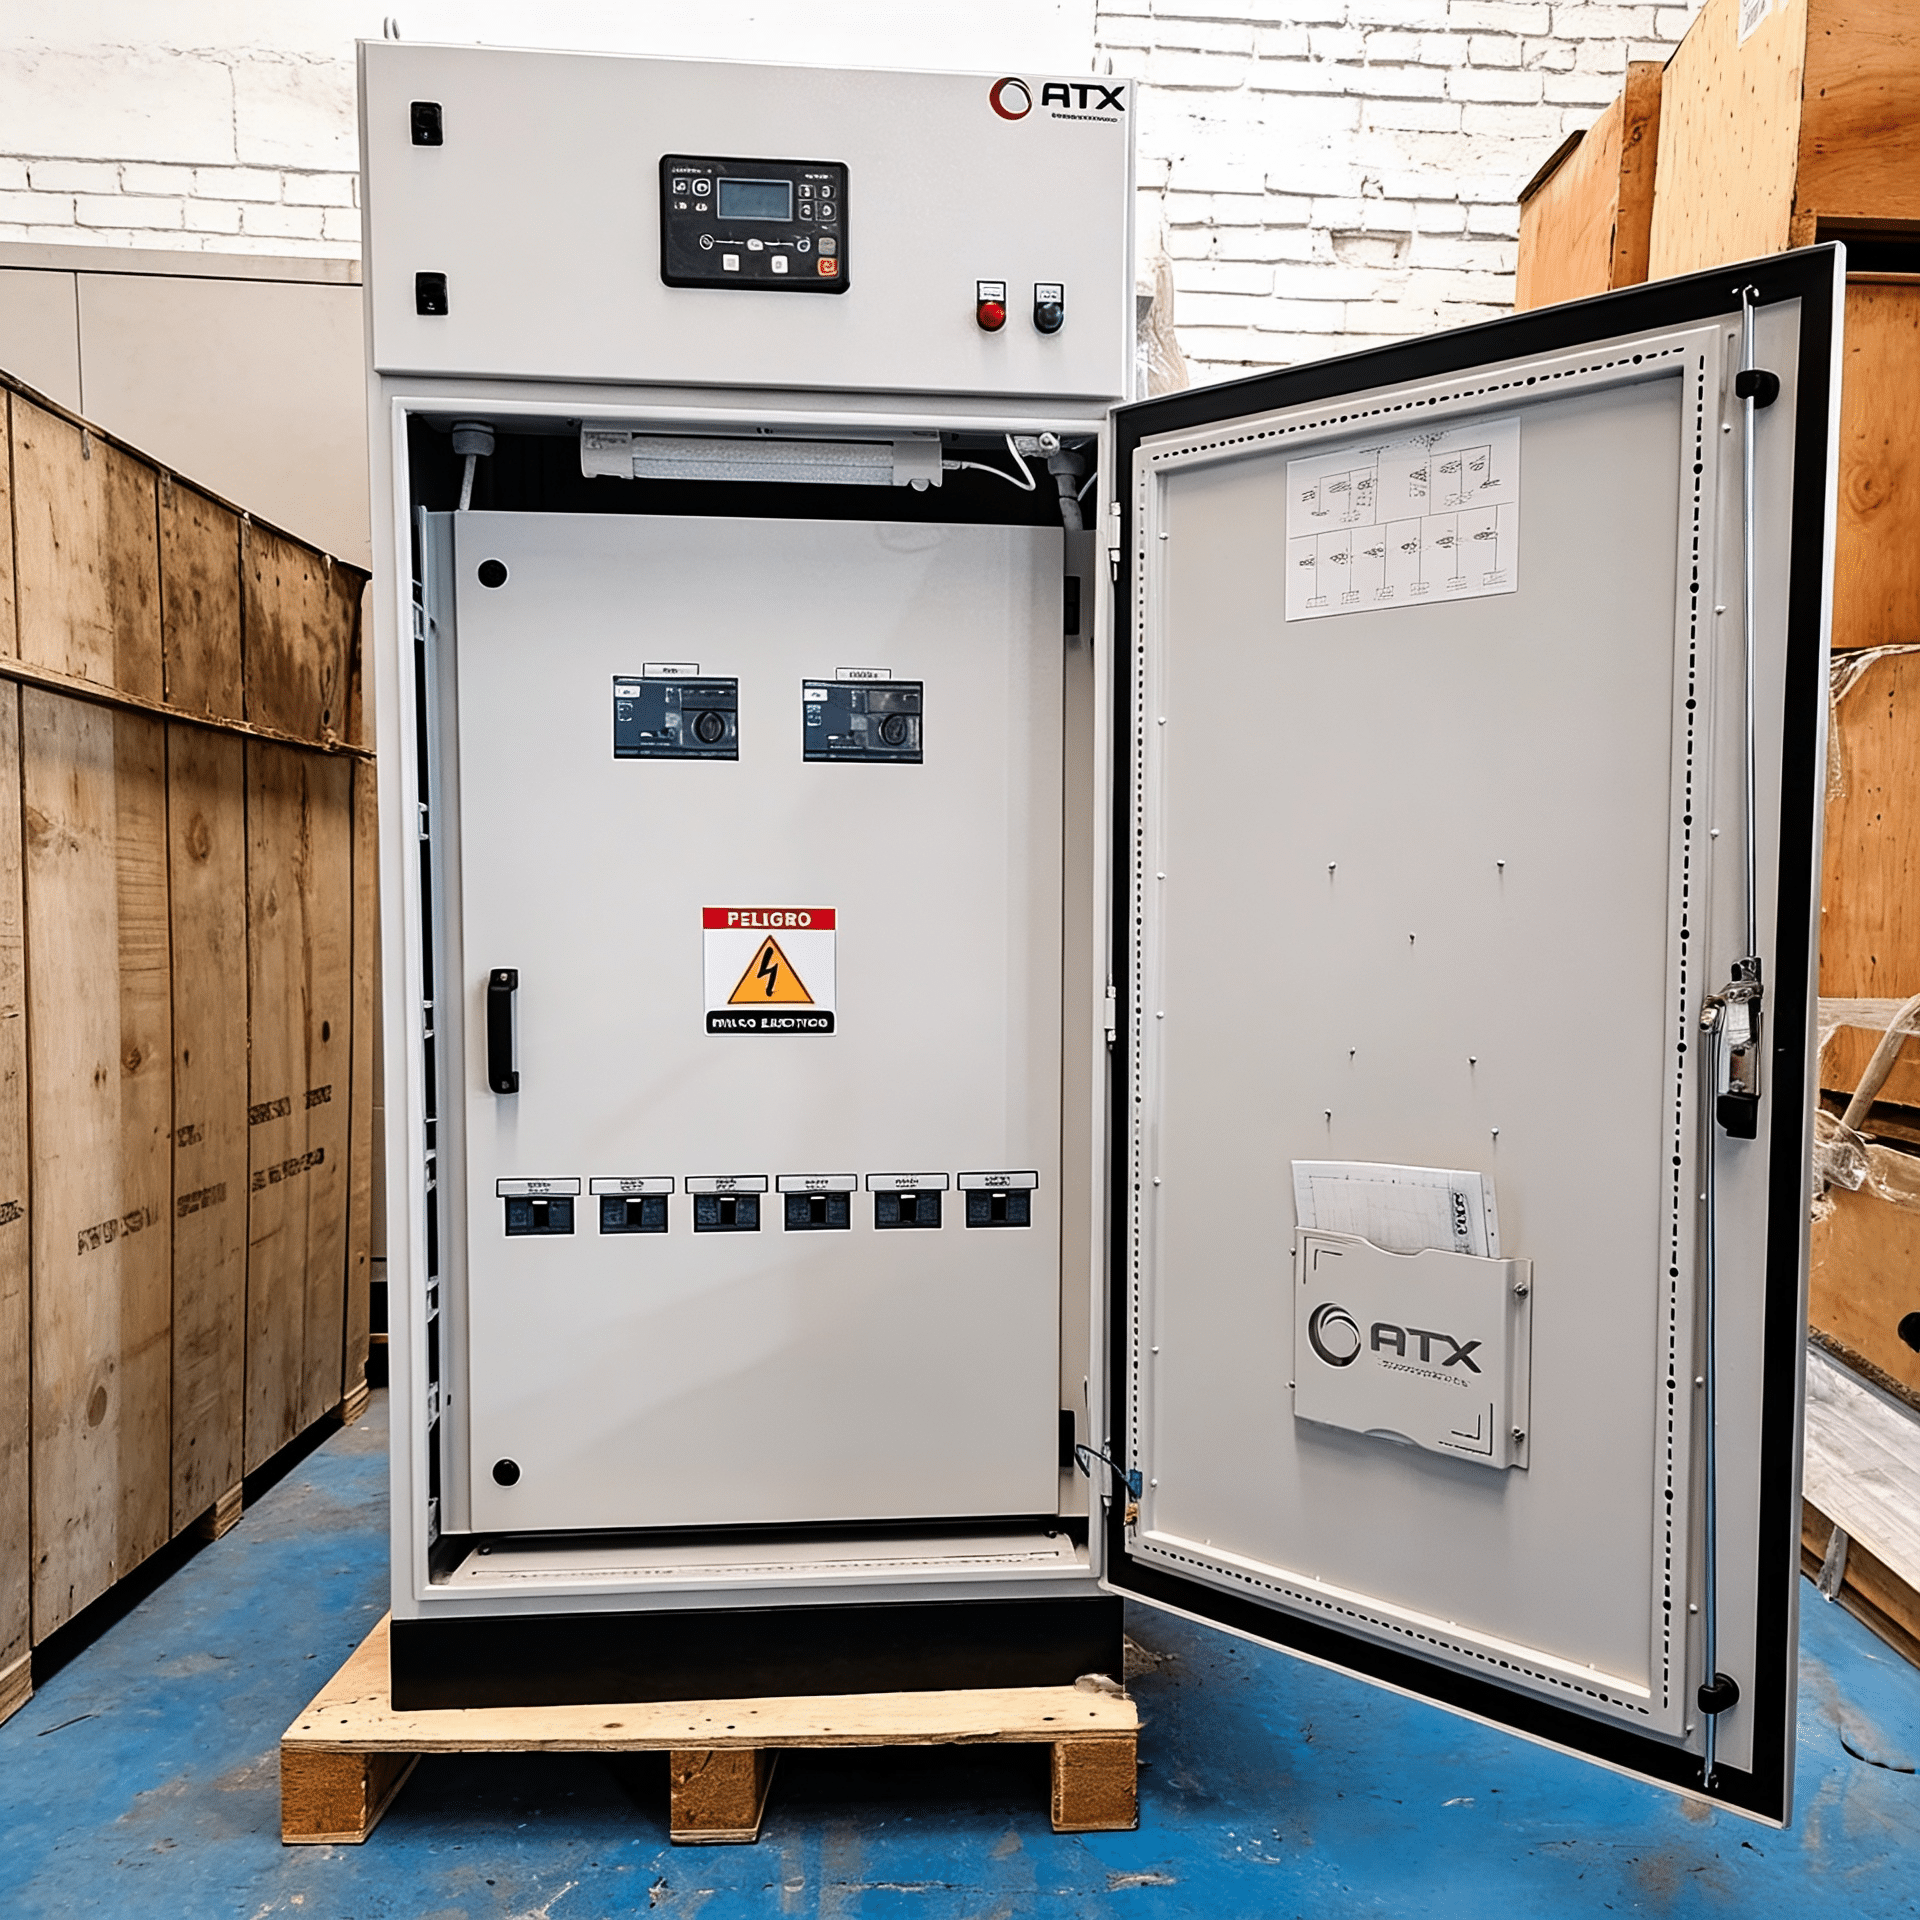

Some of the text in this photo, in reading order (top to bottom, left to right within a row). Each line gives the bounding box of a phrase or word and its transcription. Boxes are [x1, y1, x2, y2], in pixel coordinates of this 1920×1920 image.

[1041, 82, 1126, 112] ATX
[727, 911, 812, 927] PELIGRO
[1370, 1321, 1483, 1375] ATX
